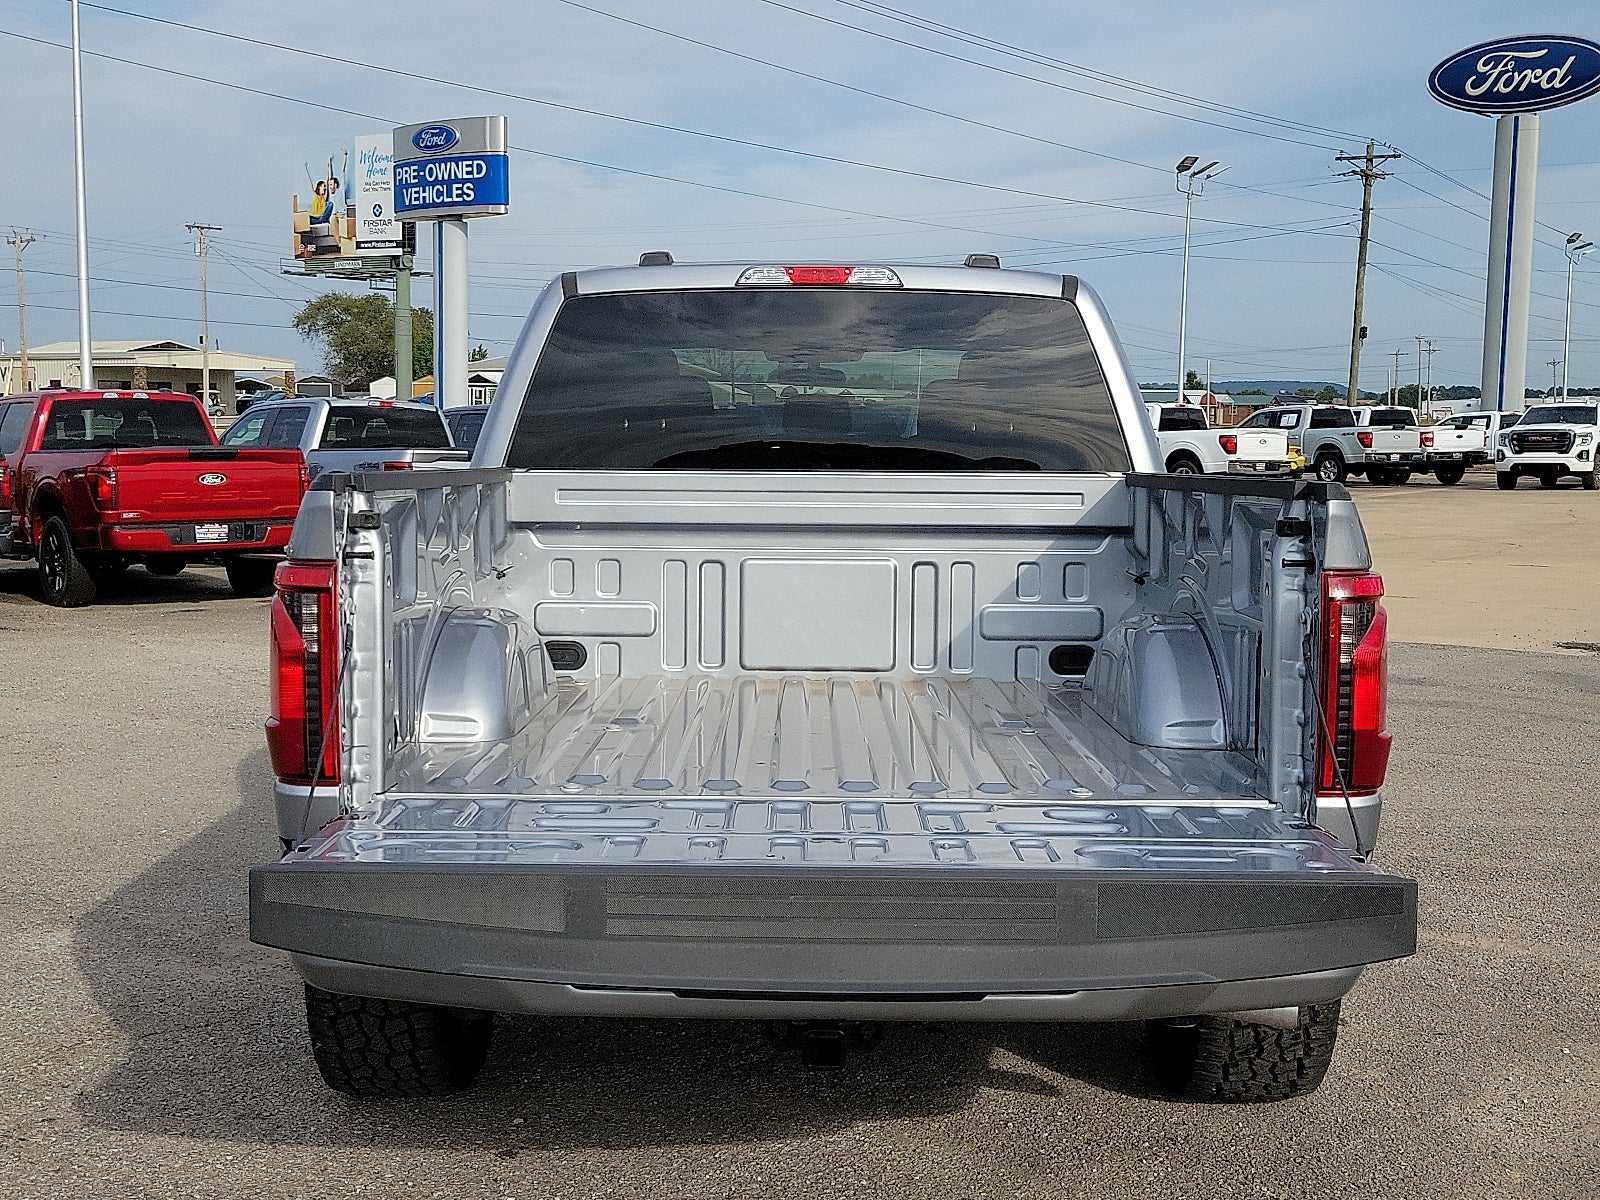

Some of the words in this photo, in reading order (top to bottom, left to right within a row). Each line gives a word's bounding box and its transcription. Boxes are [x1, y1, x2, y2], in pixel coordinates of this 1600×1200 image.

[1464, 48, 1576, 97] Ford
[419, 128, 447, 147] Ford
[359, 146, 394, 164] Welcome
[366, 164, 388, 179] Home
[395, 159, 487, 186] PRE-OWNED
[402, 183, 475, 206] VEHICLES
[363, 218, 393, 227] FIRSTAR
[369, 227, 387, 235] BANK
[203, 475, 222, 484] Ford
